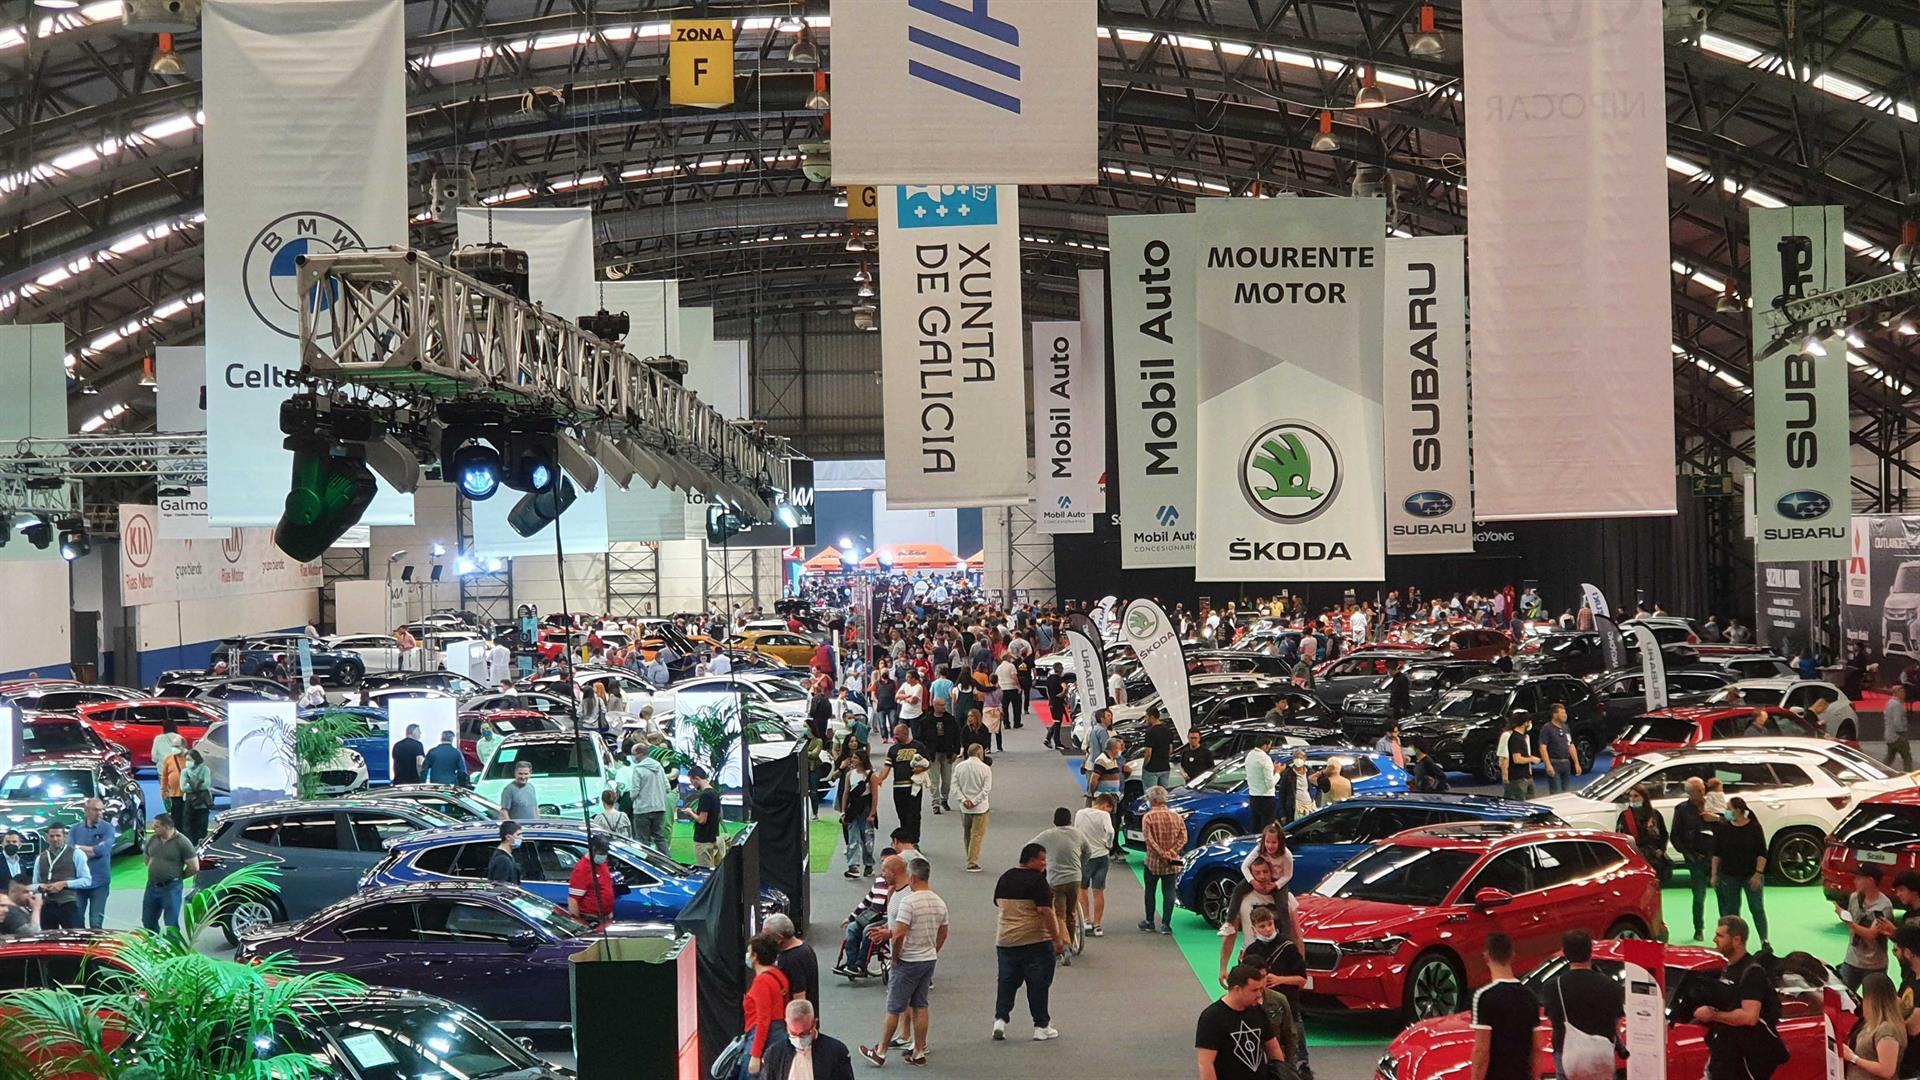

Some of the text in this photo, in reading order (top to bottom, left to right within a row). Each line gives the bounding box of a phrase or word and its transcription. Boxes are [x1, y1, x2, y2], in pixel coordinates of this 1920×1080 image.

[676, 28, 724, 41] ZONA
[693, 58, 709, 86] F
[862, 186, 876, 206] G
[261, 218, 355, 253] BMW
[1207, 246, 1374, 269] MOURENTE
[1234, 282, 1347, 304] MOTOR
[958, 242, 995, 382] XUNTA
[916, 243, 956, 474] DE GALICIA
[1139, 240, 1179, 475] Mobil Auto
[1781, 236, 1818, 469] SUBU
[1408, 262, 1441, 472] SUBARU
[1050, 336, 1072, 478] Mobil Auto
[1043, 511, 1086, 519] Mobil Auto
[129, 526, 149, 555] KIA
[1133, 530, 1196, 544] Mobil Aut
[1393, 523, 1466, 536] SUBARU
[1764, 527, 1845, 540] SUBARU
[1228, 537, 1353, 561] ŠKODA
[1140, 631, 1175, 660] ŠKODA
